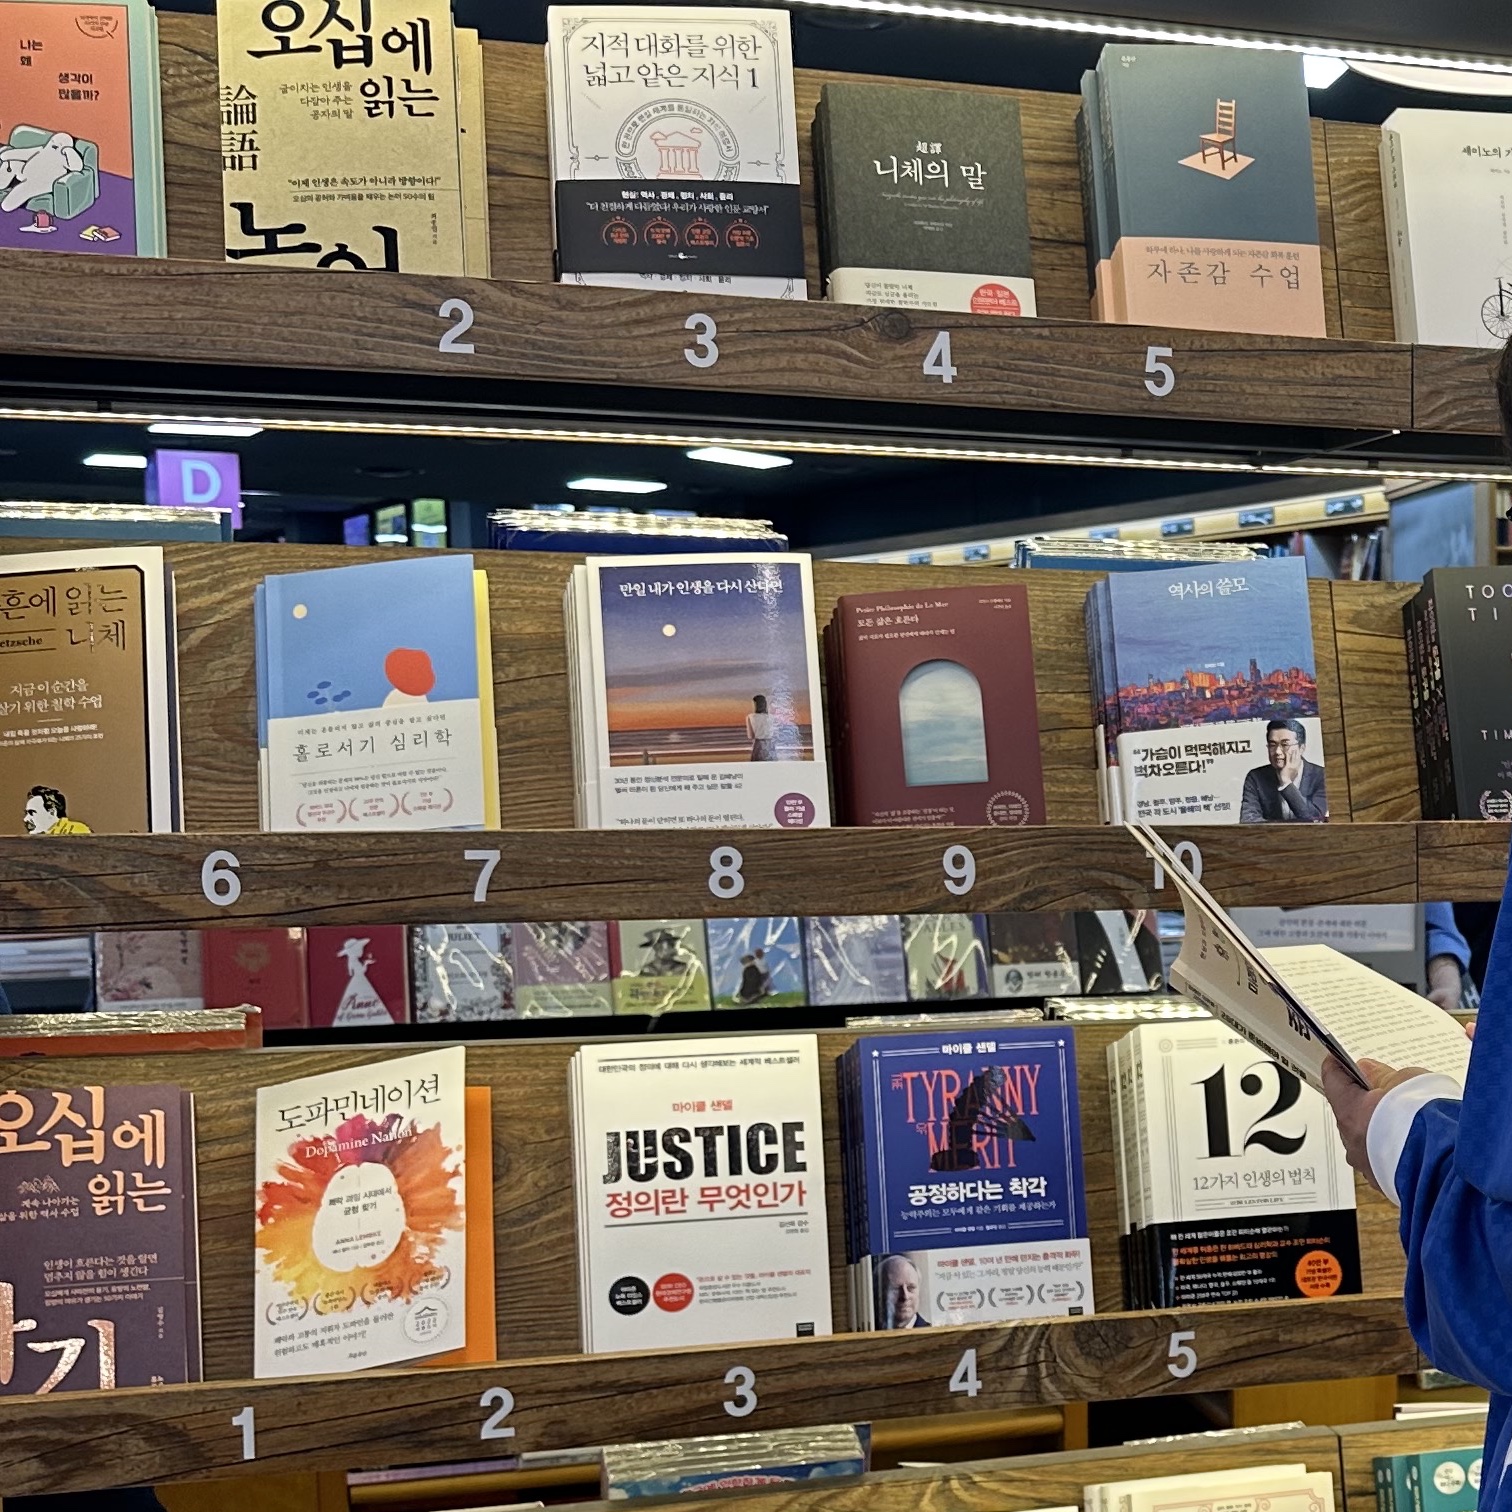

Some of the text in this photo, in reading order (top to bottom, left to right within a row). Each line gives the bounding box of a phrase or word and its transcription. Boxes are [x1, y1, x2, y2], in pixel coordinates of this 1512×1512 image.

[20, 40, 43, 51] 나는
[247, 0, 433, 76] 오십에
[581, 32, 762, 62] 지적 대화를 위한
[58, 73, 93, 85] 생각이
[360, 75, 440, 119] 읽는
[585, 62, 760, 90] 넓고 얕은 지식 1
[873, 156, 988, 191] 니체의 말
[1147, 258, 1300, 290] 자존감 수업
[438, 299, 475, 354] 2
[684, 313, 720, 367] 3
[922, 331, 958, 383] 4
[1144, 346, 1176, 396] 5
[182, 459, 222, 503] D
[619, 582, 647, 597] 만일
[648, 581, 675, 596] 내가
[676, 579, 715, 595] 인생을
[716, 579, 743, 594] 다시
[292, 728, 452, 763] 홀로서기 심리학
[1184, 739, 1253, 758] 먹먹해지고
[201, 850, 242, 907] 6
[464, 849, 501, 903] 7
[708, 846, 745, 899] 8
[942, 844, 976, 896] 9
[275, 1074, 442, 1133] 도파민네이션
[1190, 1062, 1309, 1160] 12
[305, 1126, 413, 1160] Dopamine Nation
[602, 1121, 807, 1185] JUSTICE
[87, 1169, 172, 1217] 읽는
[605, 1181, 807, 1219] 정의란 무엇인가
[908, 1176, 1048, 1207] 공정하다는 착각
[1193, 1167, 1316, 1191] 12가지 인생의 법칙
[942, 1206, 974, 1218] 모두에게
[993, 1203, 1017, 1214] 기회를
[44, 1260, 73, 1272] 인생이
[949, 1348, 982, 1397] 4
[1167, 1331, 1197, 1379] 5
[480, 1386, 516, 1440] 2
[723, 1366, 758, 1418] 3
[232, 1406, 256, 1461] 1
